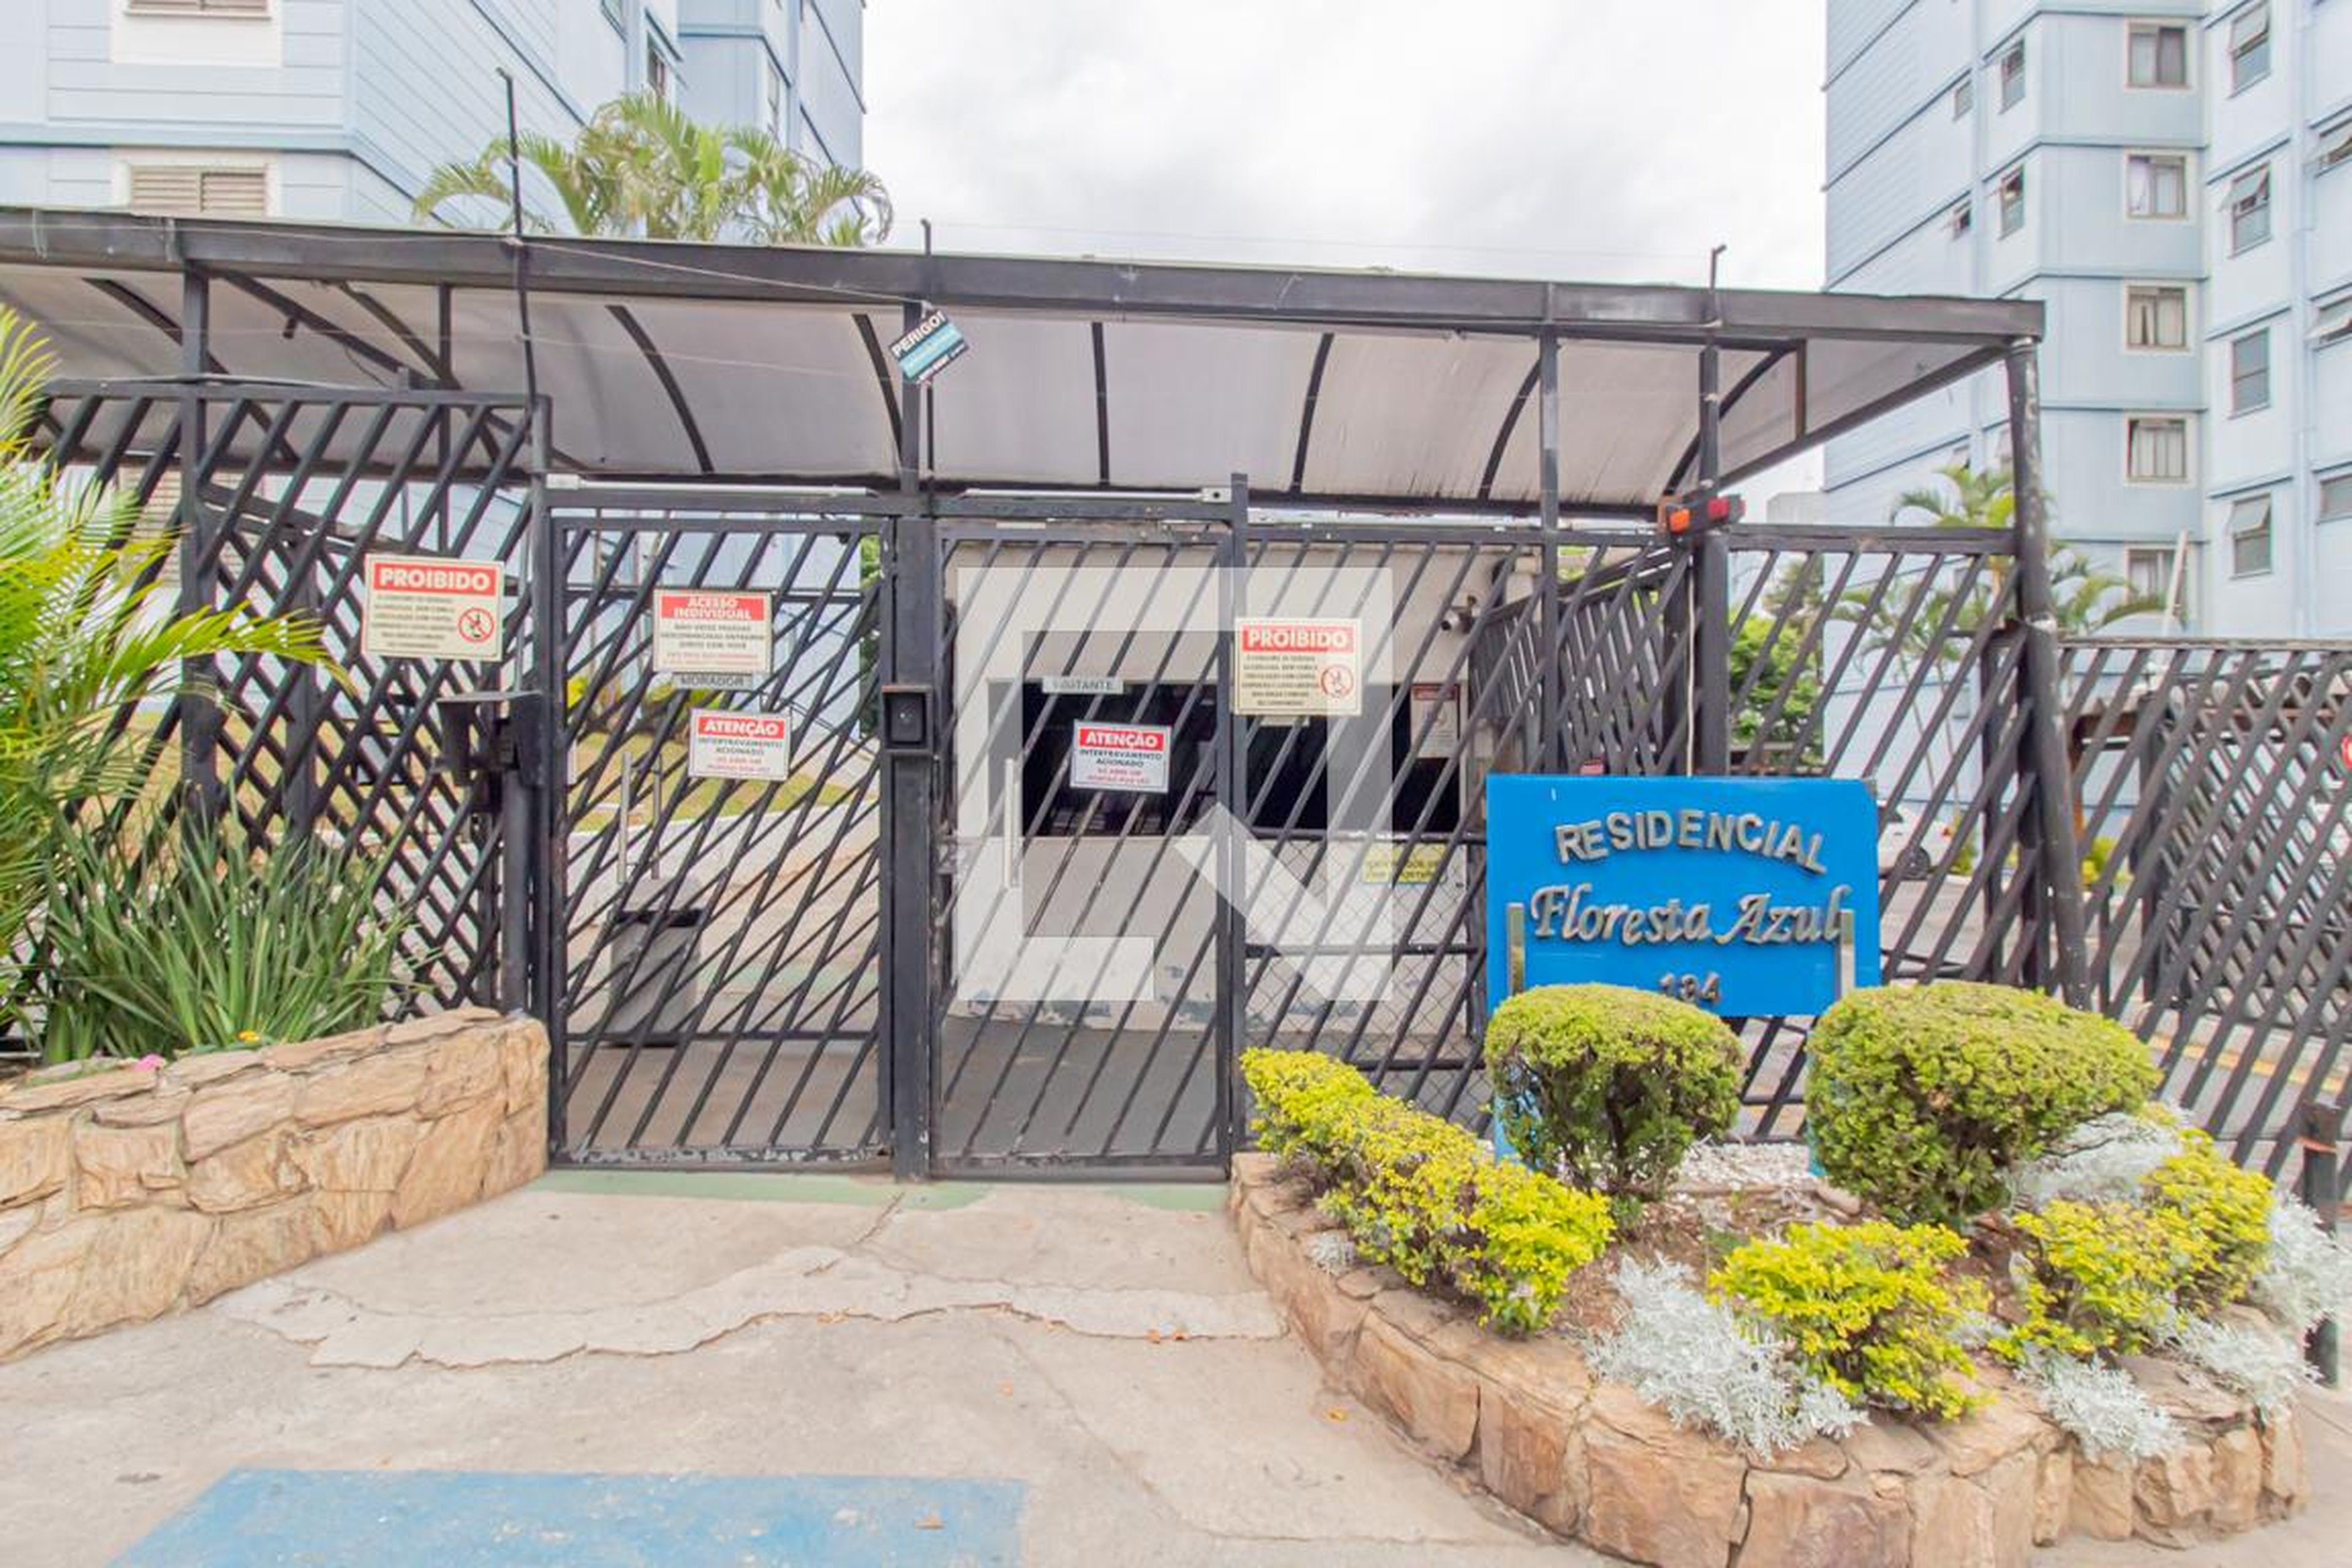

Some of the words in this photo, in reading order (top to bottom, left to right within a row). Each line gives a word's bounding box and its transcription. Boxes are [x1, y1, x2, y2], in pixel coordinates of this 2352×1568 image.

[891, 310, 946, 358] PERIGO!
[380, 568, 490, 590] PROIBIDO
[687, 596, 739, 607] ACESSO
[674, 608, 752, 620] INDIVIDUAL
[1248, 628, 1348, 647] PROIBIDO
[680, 676, 744, 687] MORADOR
[705, 718, 780, 737] ATENÇÃO
[1086, 731, 1158, 748] ATENÇÃO
[1096, 758, 1144, 768] ACIONADO
[1556, 810, 1828, 875] RESIDENCIAL
[1531, 883, 1713, 945] Floresta
[1713, 883, 1853, 944] Azul
